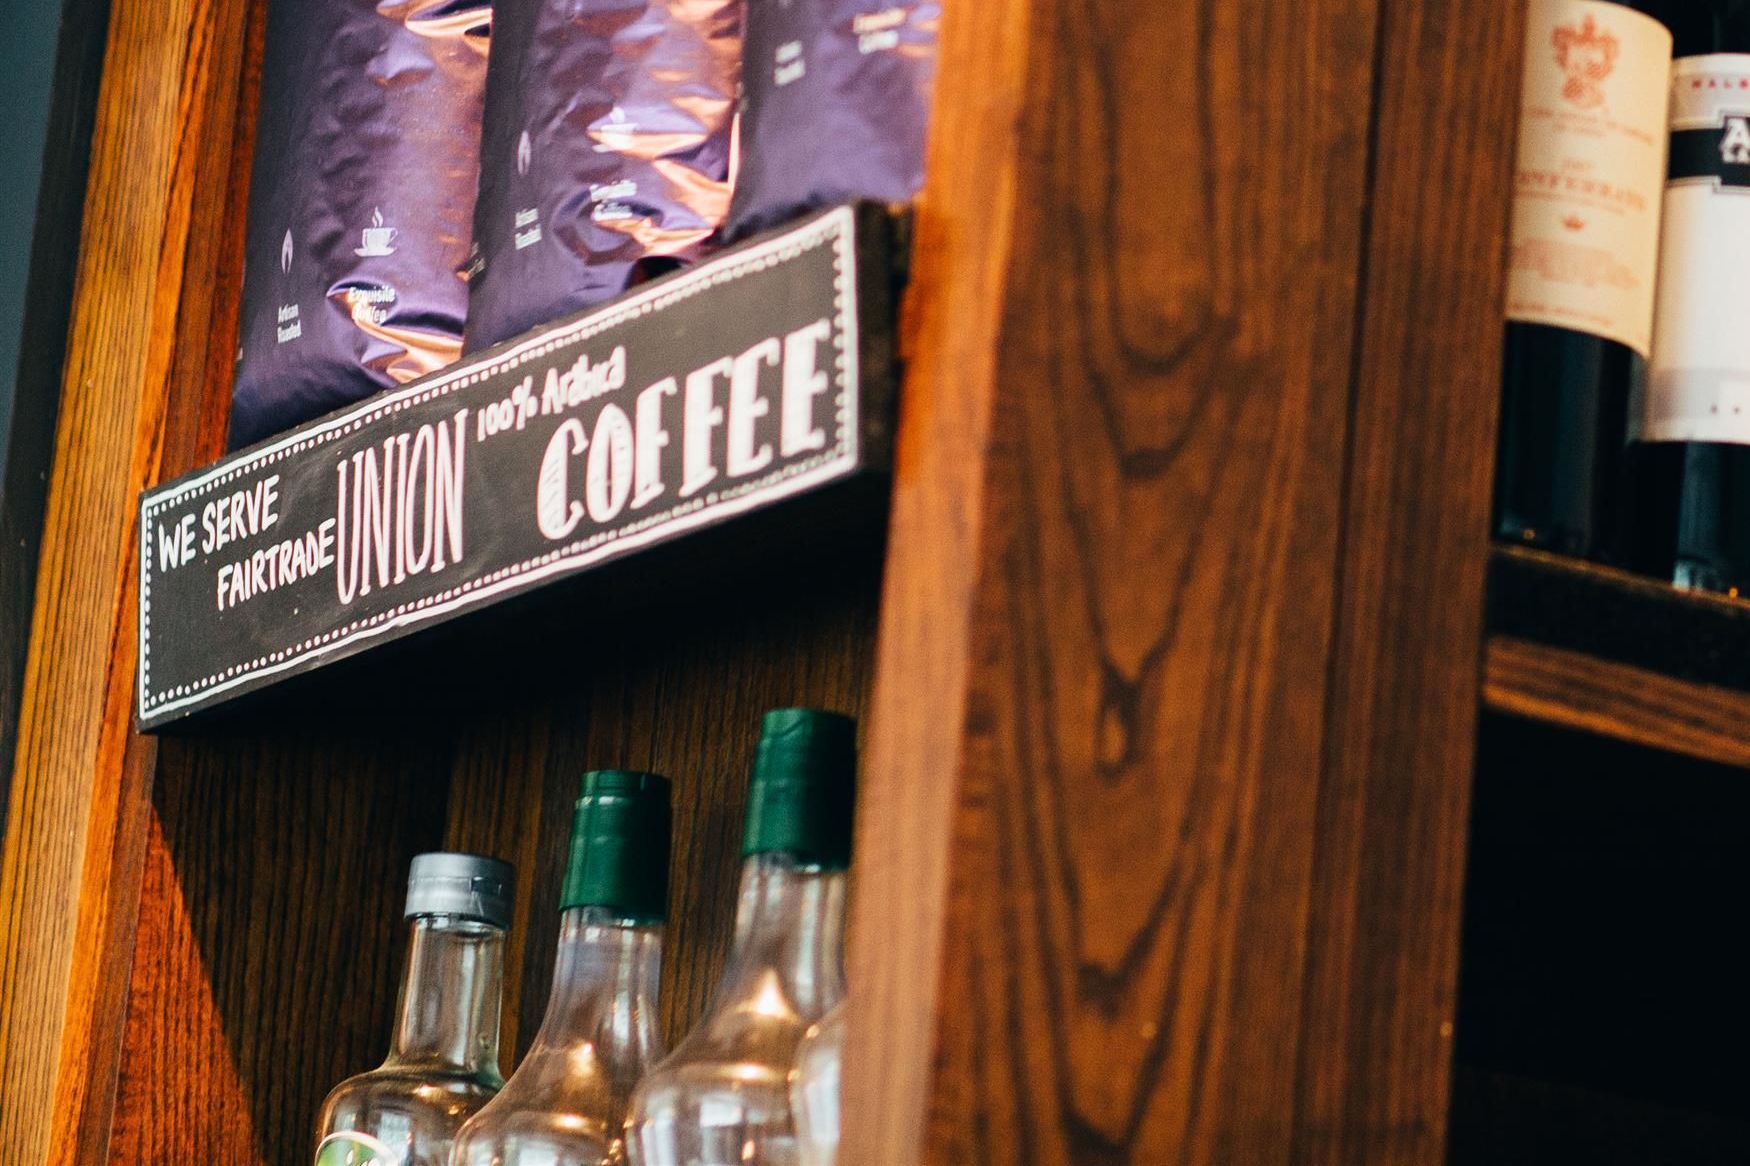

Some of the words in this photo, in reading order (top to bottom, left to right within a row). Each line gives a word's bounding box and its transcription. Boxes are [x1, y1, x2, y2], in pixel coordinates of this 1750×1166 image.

[349, 286, 395, 304] Exquisite
[477, 375, 538, 442] 100%
[536, 318, 831, 540] COFFEE
[158, 513, 196, 572] WE
[202, 474, 280, 555] SERVE
[336, 408, 469, 605] UNION
[217, 517, 336, 611] FAIRTRADE
